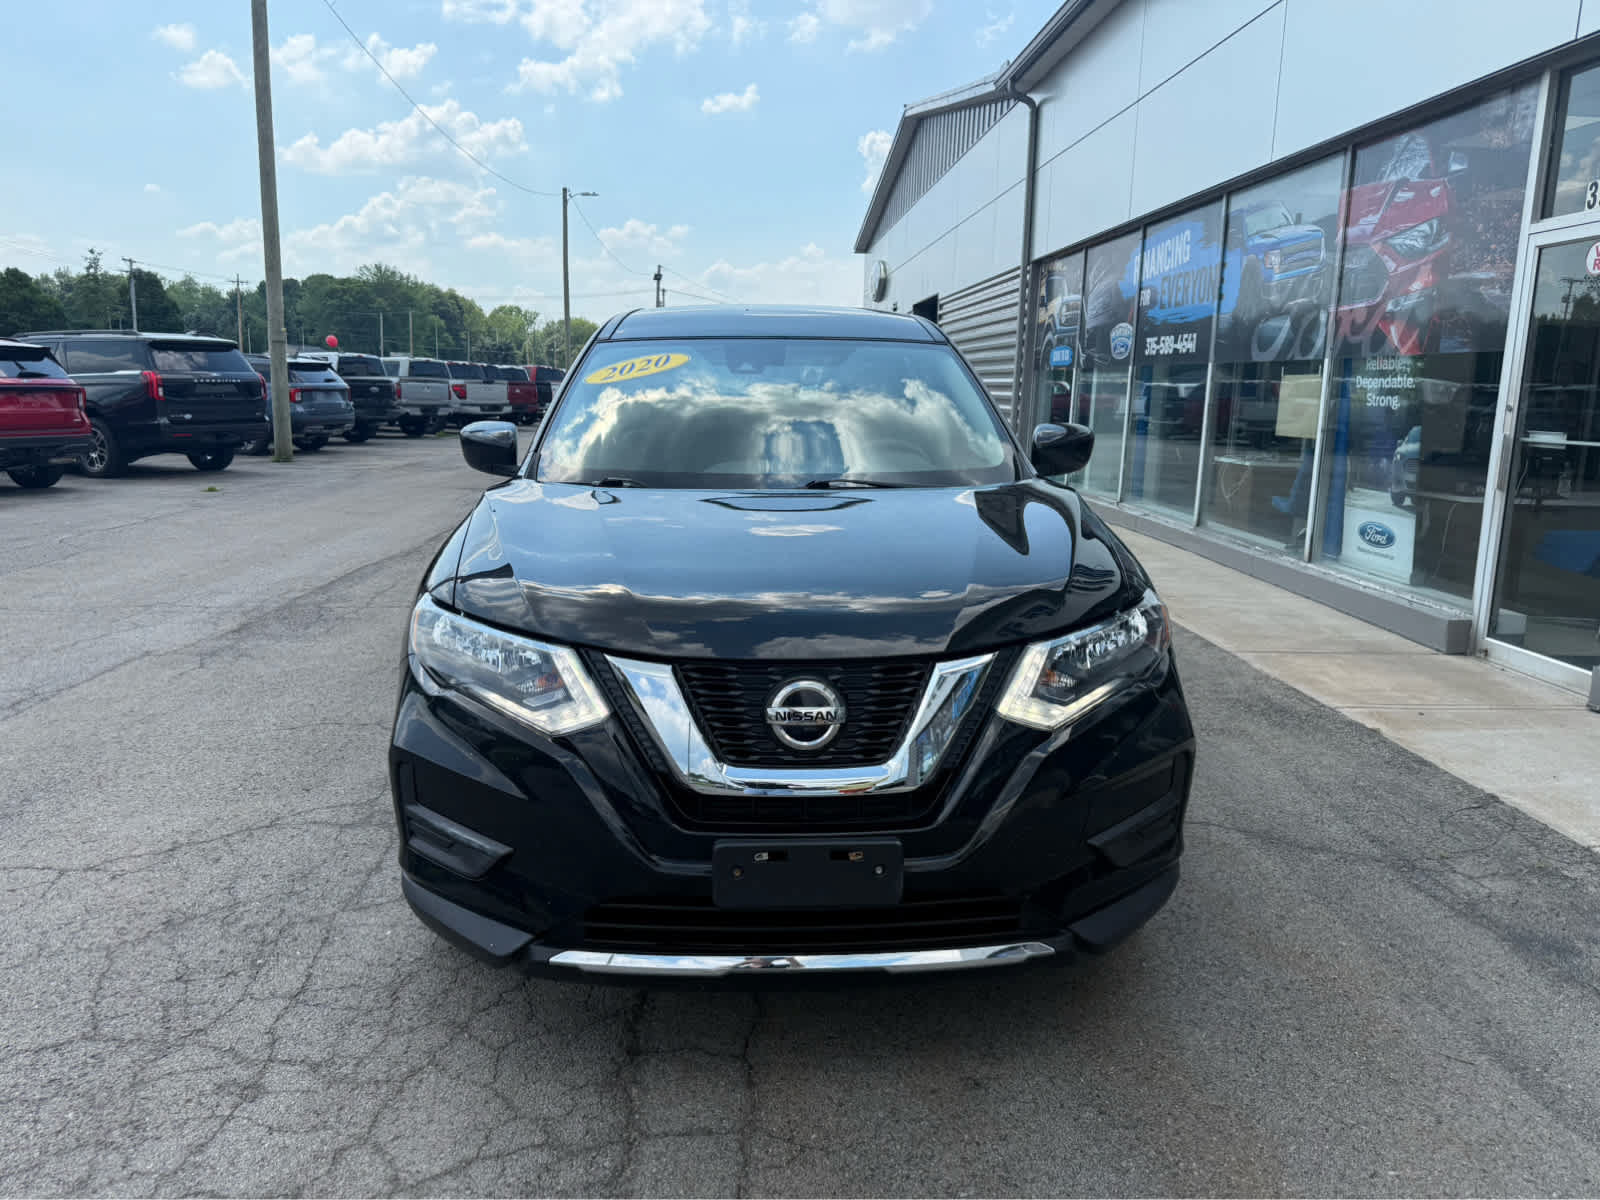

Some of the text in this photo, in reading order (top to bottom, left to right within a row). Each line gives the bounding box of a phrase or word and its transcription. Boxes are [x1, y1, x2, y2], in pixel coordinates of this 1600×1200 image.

[602, 355, 671, 381] 2020
[1356, 375, 1416, 391] Dependable.
[1366, 392, 1400, 410] Strong.
[1365, 524, 1388, 544] Ford
[775, 711, 837, 721] NISSAN
